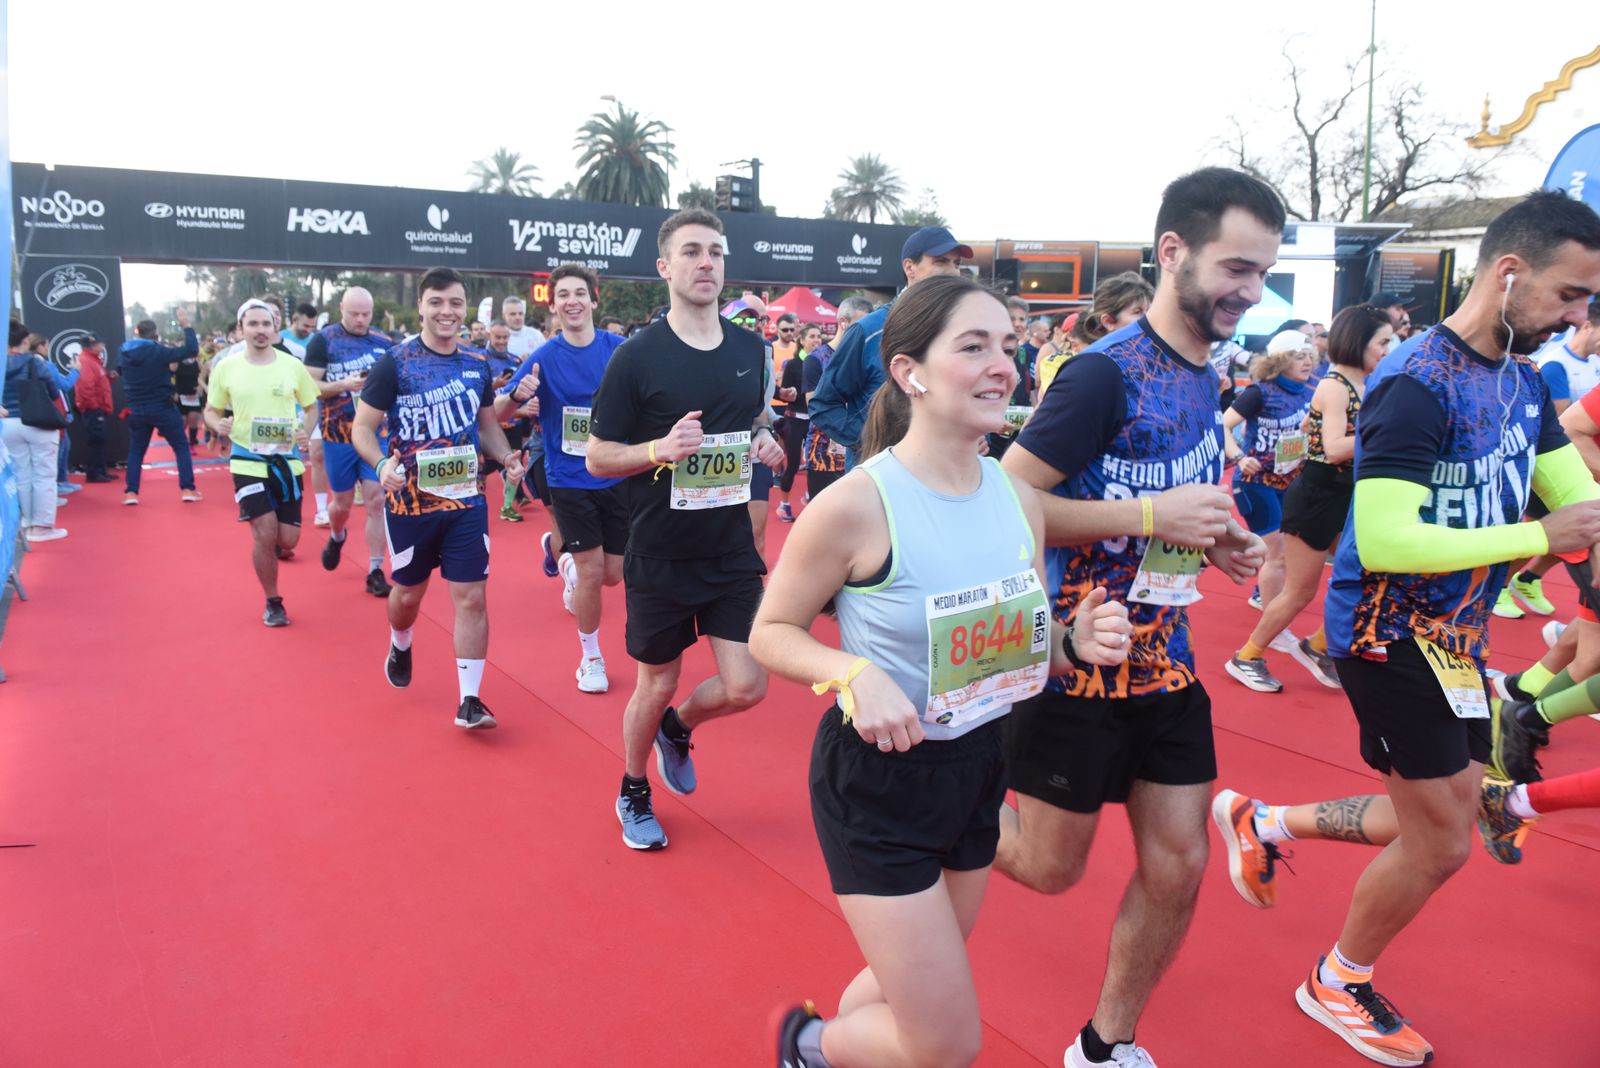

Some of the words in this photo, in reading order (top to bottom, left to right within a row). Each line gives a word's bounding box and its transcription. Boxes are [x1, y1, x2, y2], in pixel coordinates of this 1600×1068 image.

[176, 205, 245, 220] HYUNDAI
[287, 206, 368, 235] HOKA
[535, 220, 623, 241] maratón
[558, 237, 626, 257] sevilla
[772, 243, 814, 254] HYUNDAI
[547, 257, 559, 267] 28
[587, 260, 609, 269] 2024
[424, 378, 466, 406] MARATÓN
[399, 388, 480, 441] SEVILLA
[257, 425, 285, 439] 6834
[428, 460, 464, 478] 8630
[686, 451, 736, 476] 8703
[1102, 453, 1166, 489] MEDIO
[1171, 428, 1220, 487] MARATÓN
[1431, 460, 1468, 487] DIO
[933, 594, 957, 611] MEDIO
[957, 586, 988, 606] MARATÓN
[1001, 574, 1029, 598] SEVILLA
[950, 609, 1025, 667] 8644
